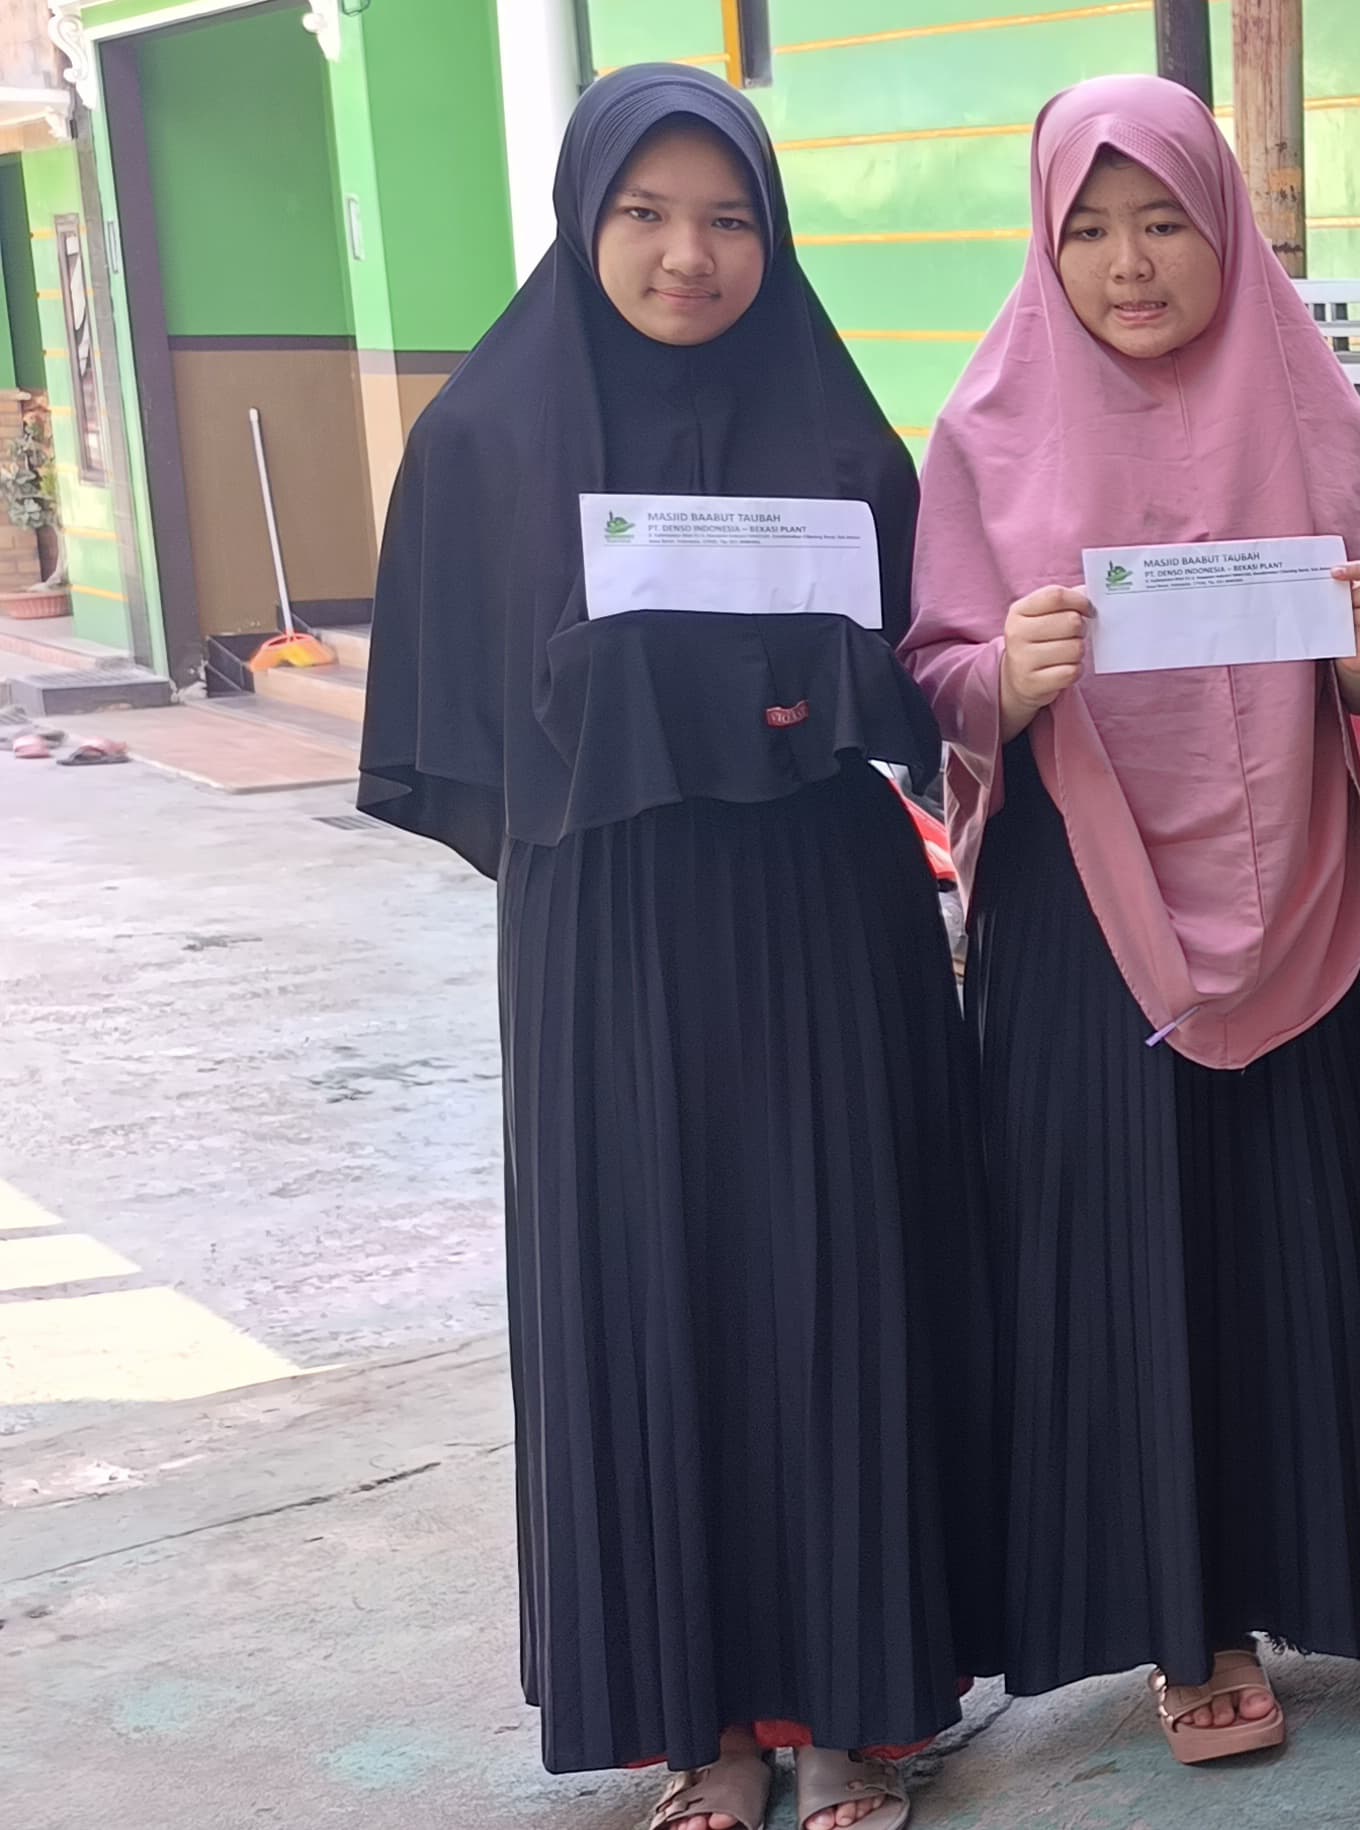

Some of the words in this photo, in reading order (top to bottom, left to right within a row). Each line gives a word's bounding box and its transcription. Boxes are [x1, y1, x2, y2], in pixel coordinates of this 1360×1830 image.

[647, 512, 688, 521] MASJID
[691, 512, 734, 521] BAABUT
[737, 513, 781, 522] TAUBAH
[750, 525, 778, 533] BEKASI
[1143, 558, 1179, 567] MASJID
[1181, 555, 1219, 565] BAABUT
[1222, 551, 1260, 562] TAUBAH
[1157, 569, 1183, 577] DENSO
[1185, 566, 1225, 574] INDONESIA
[1233, 563, 1258, 571] BEKASI
